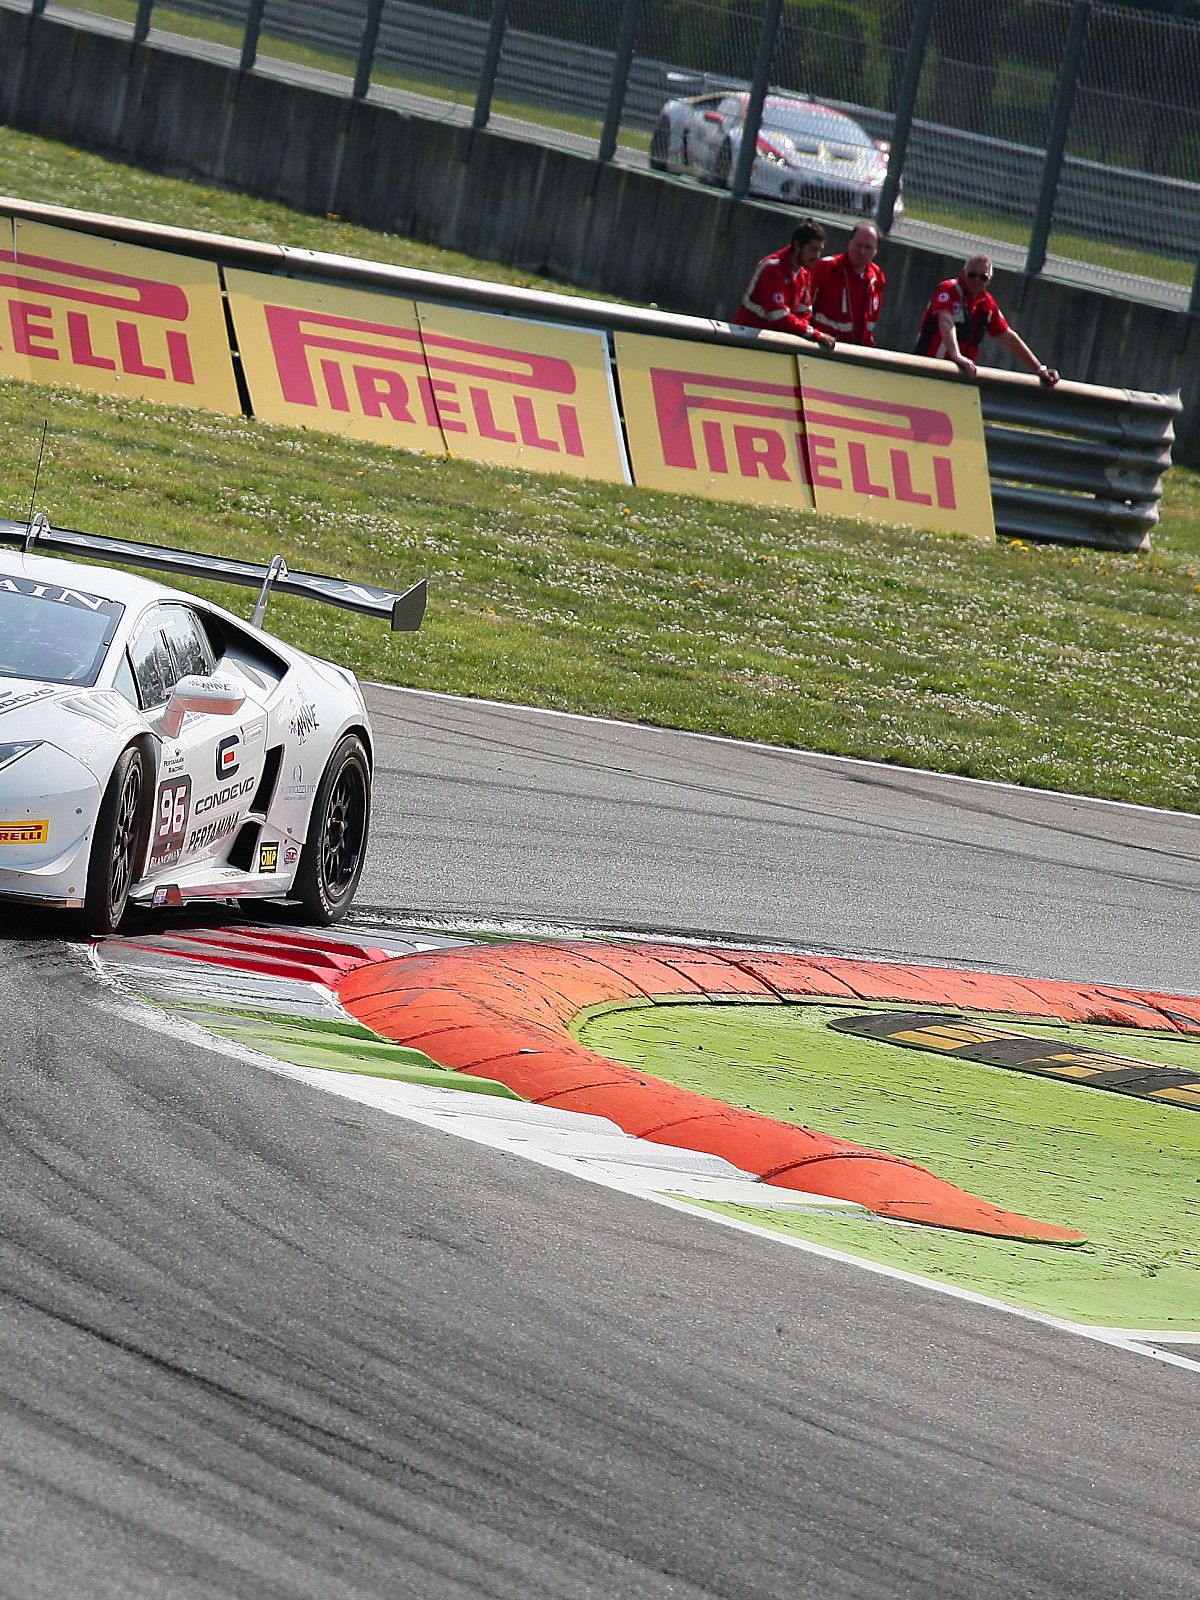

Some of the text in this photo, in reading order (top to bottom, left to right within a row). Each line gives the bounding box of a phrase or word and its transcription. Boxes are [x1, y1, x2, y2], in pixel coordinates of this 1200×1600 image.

[263, 303, 586, 458] PIRELLI
[650, 366, 957, 511] PIRELLI
[159, 783, 187, 838] 96
[194, 776, 255, 816] CONDEVO
[187, 811, 241, 854] PERTAMINA
[261, 850, 277, 866] OMP
